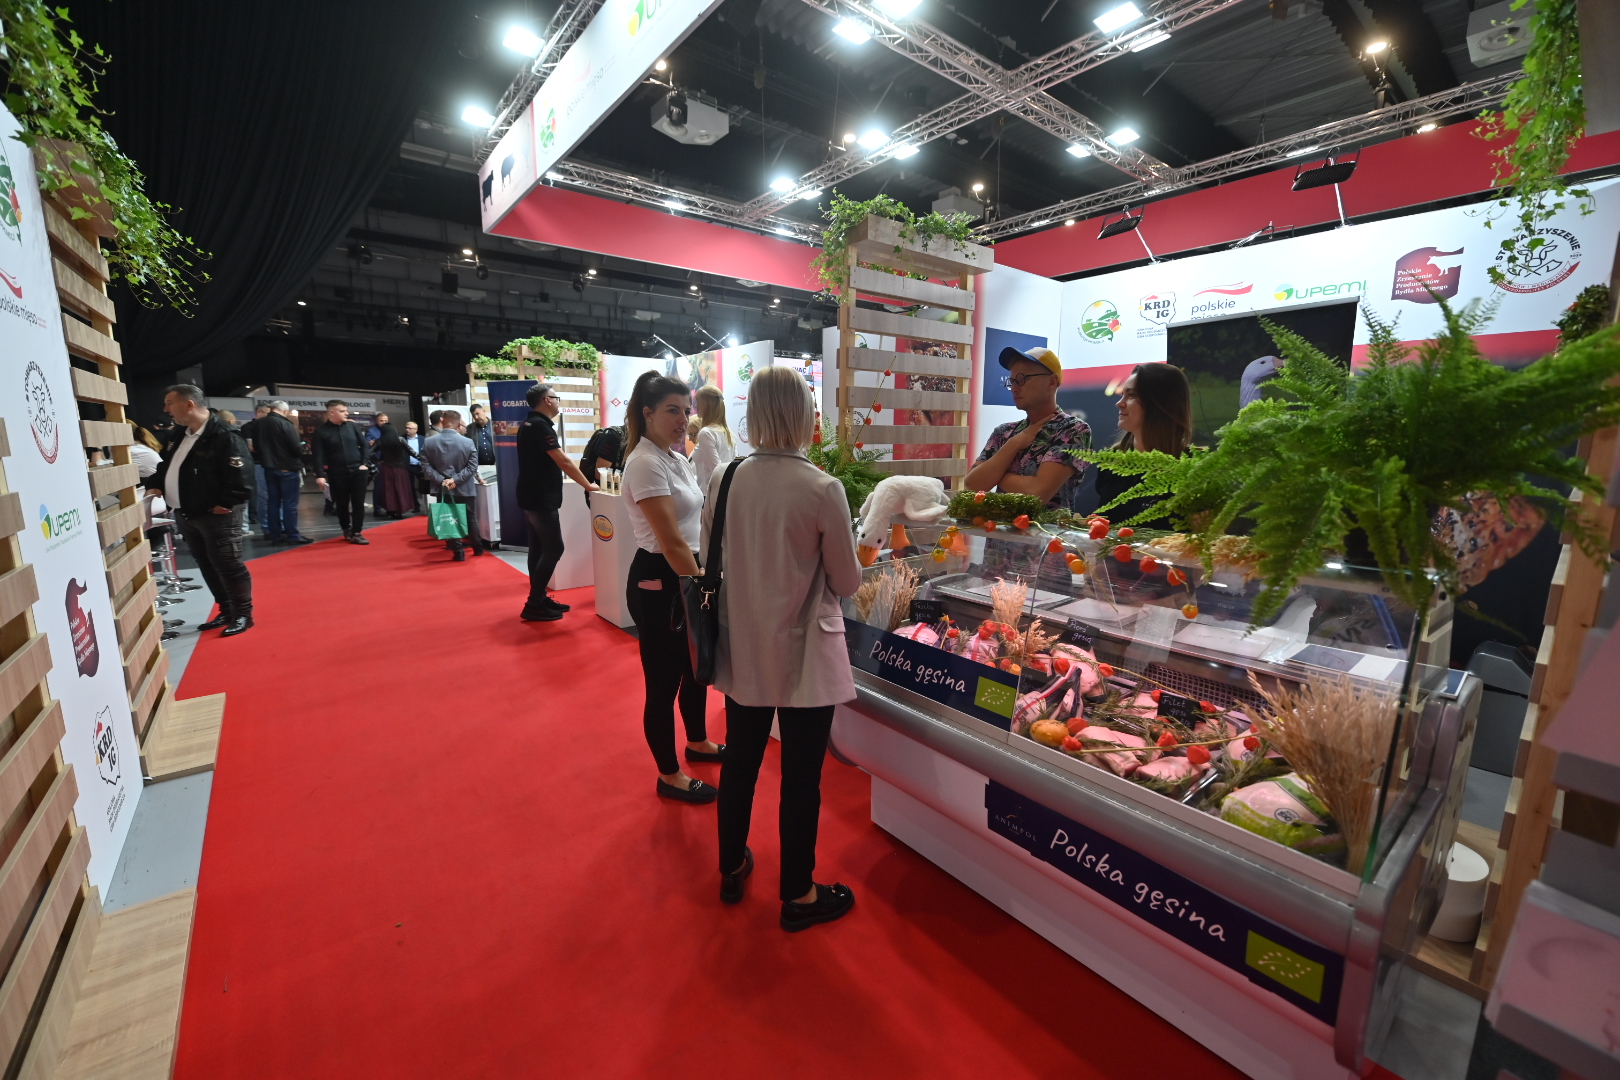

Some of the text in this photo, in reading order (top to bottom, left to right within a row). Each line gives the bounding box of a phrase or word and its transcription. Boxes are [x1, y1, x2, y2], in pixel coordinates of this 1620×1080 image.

[1144, 299, 1170, 311] KRD
[1191, 299, 1236, 315] polskie
[1156, 309, 1169, 319] IG
[288, 400, 318, 408] MIĘSNE
[869, 640, 966, 694] Polska gęsina
[97, 726, 112, 763] KRD
[1049, 828, 1226, 943] Polska gęsina
